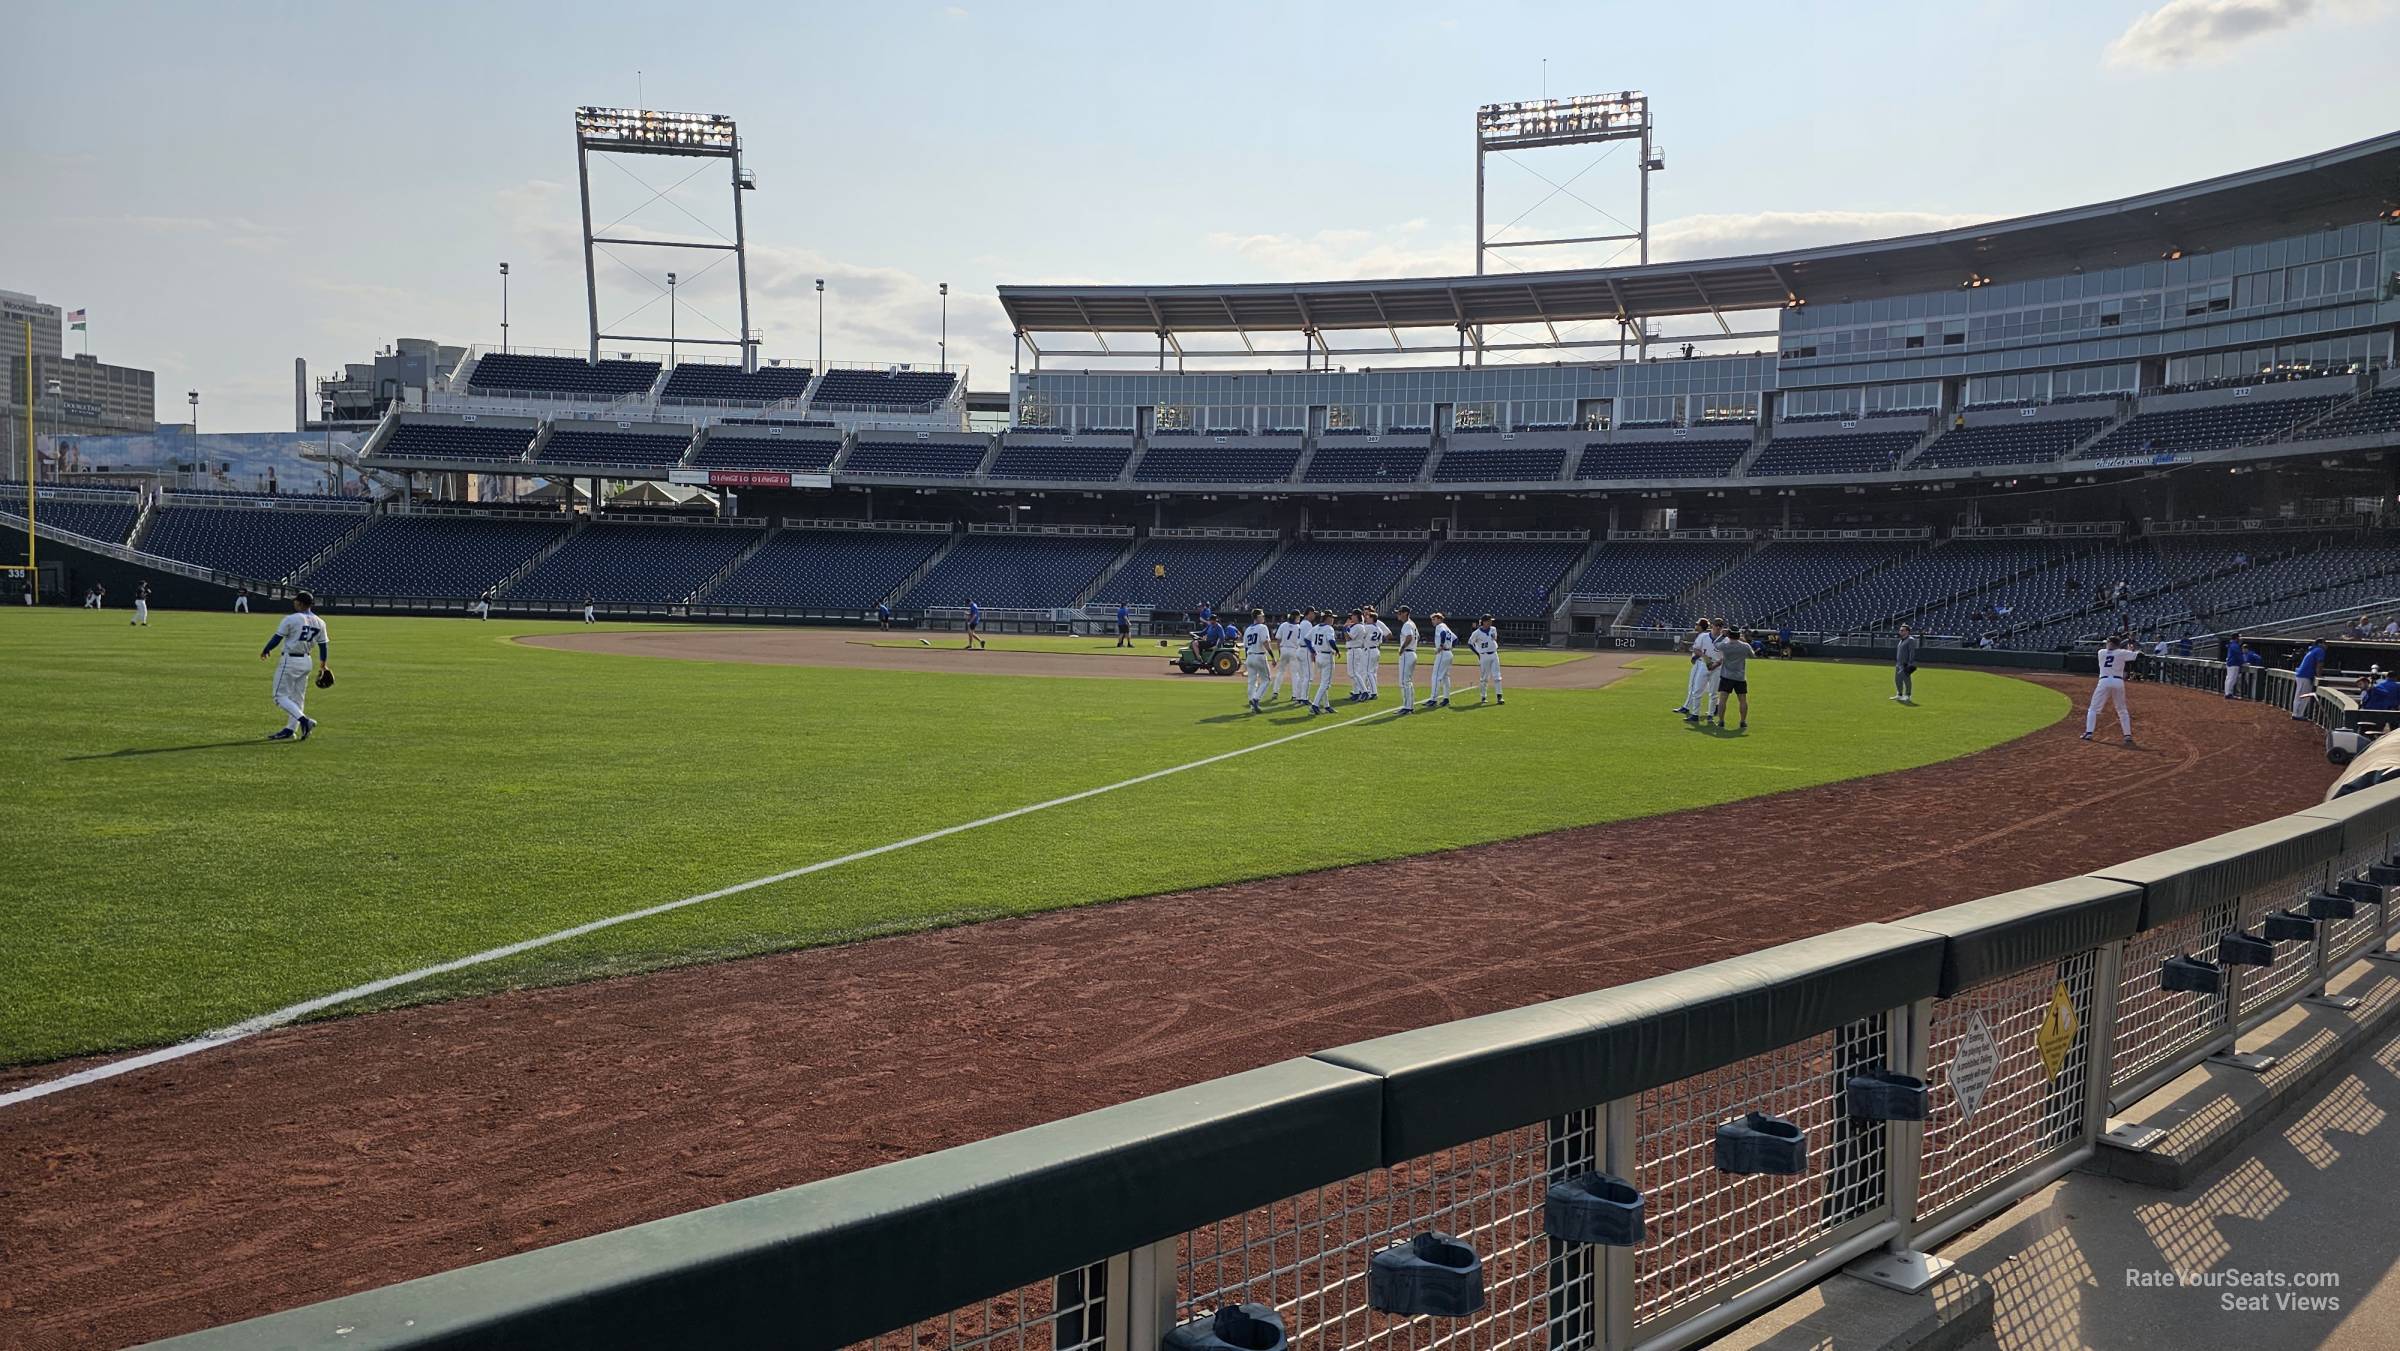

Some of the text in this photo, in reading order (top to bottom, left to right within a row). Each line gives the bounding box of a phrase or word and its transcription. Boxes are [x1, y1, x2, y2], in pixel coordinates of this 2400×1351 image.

[8, 569, 25, 578] 335
[298, 625, 321, 642] 27
[1246, 632, 1258, 646] 20
[1314, 633, 1324, 645] 15
[1615, 638, 1636, 648] 0:20
[2103, 655, 2115, 668] 2
